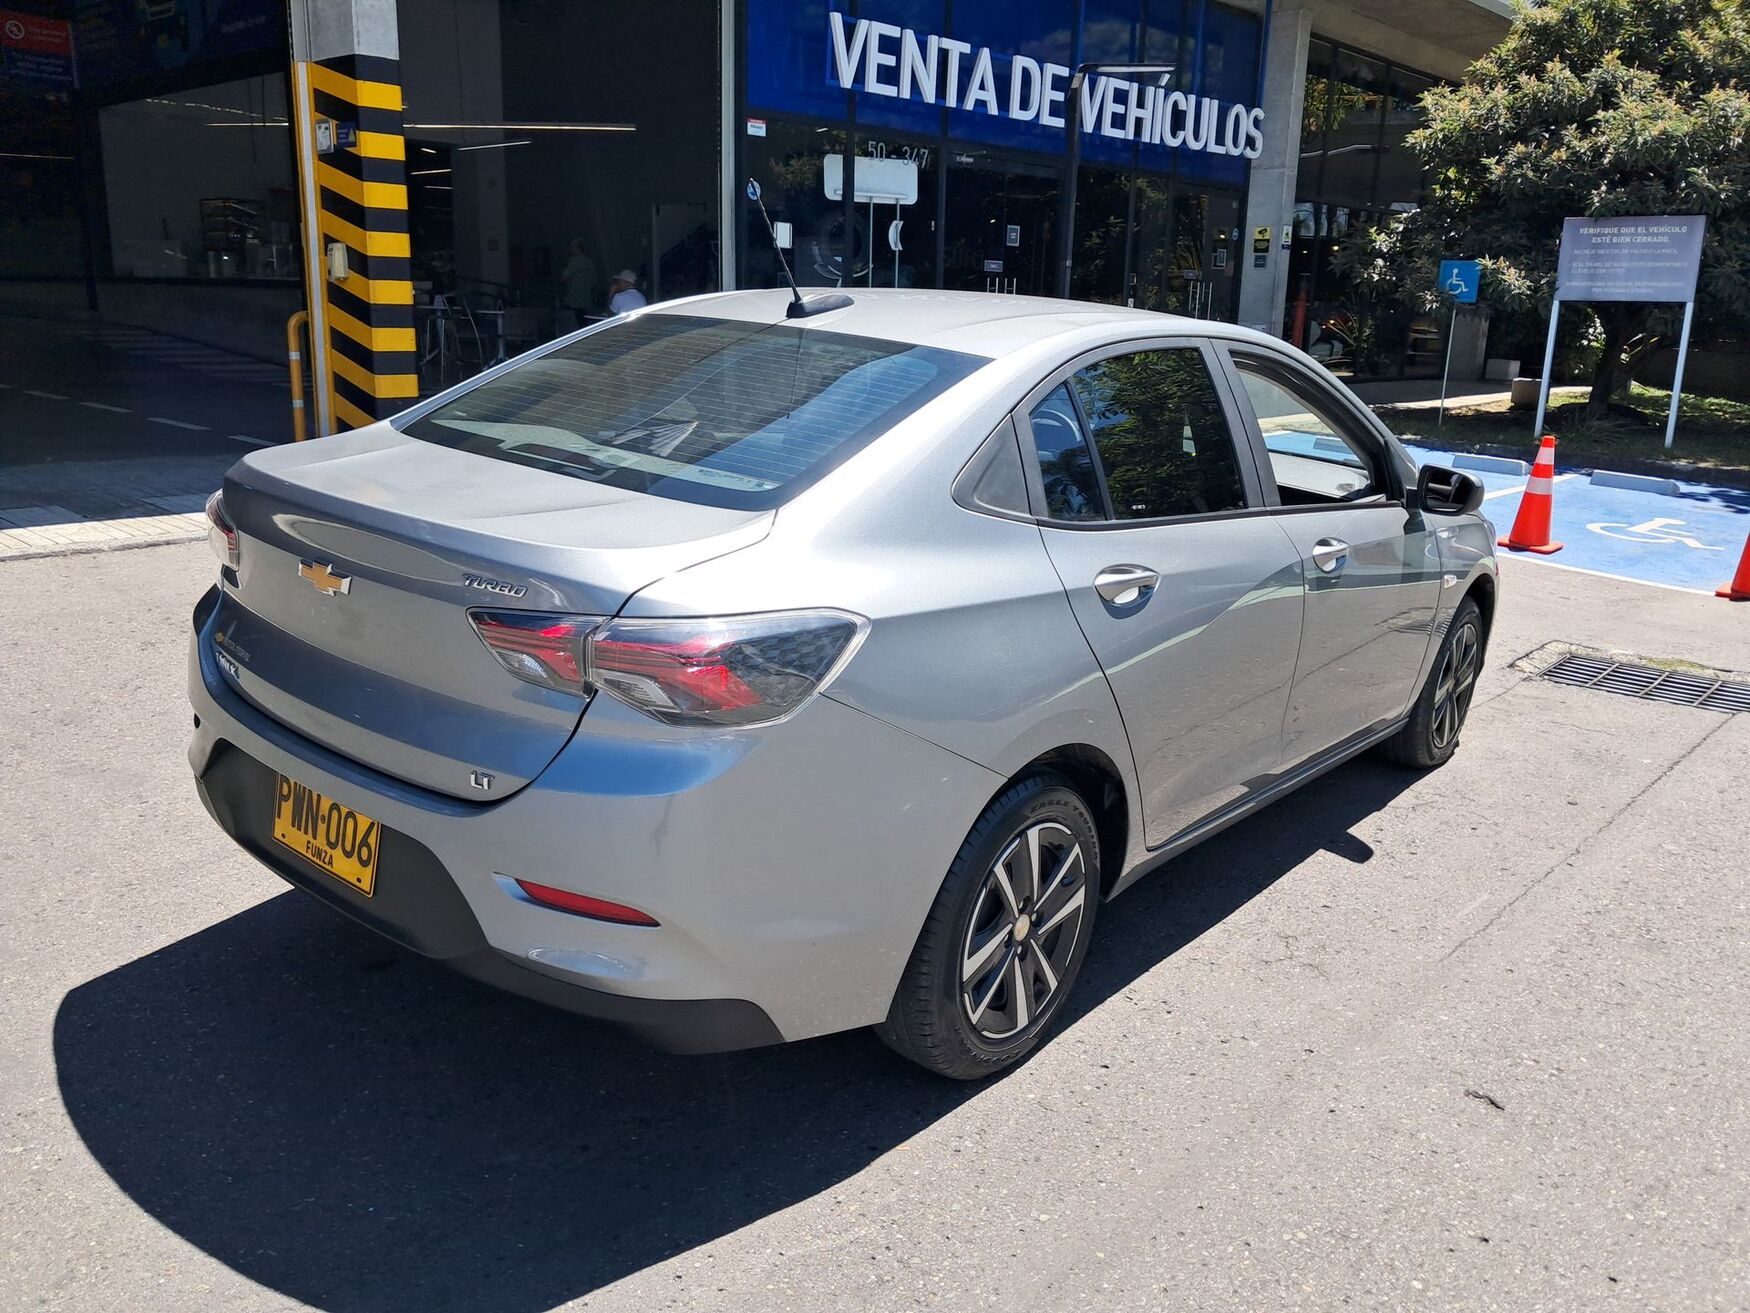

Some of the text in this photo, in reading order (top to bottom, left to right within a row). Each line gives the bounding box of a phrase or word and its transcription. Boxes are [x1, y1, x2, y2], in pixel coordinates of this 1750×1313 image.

[830, 12, 1265, 159] VENTA DE VEHÍCULOS
[868, 141, 886, 162] 50
[1591, 234, 1610, 243] ESTÉ
[1649, 224, 1688, 233] VEHÍCULO
[463, 573, 529, 598] TURBO
[470, 768, 496, 796] LT
[305, 840, 334, 869] FUNZA
